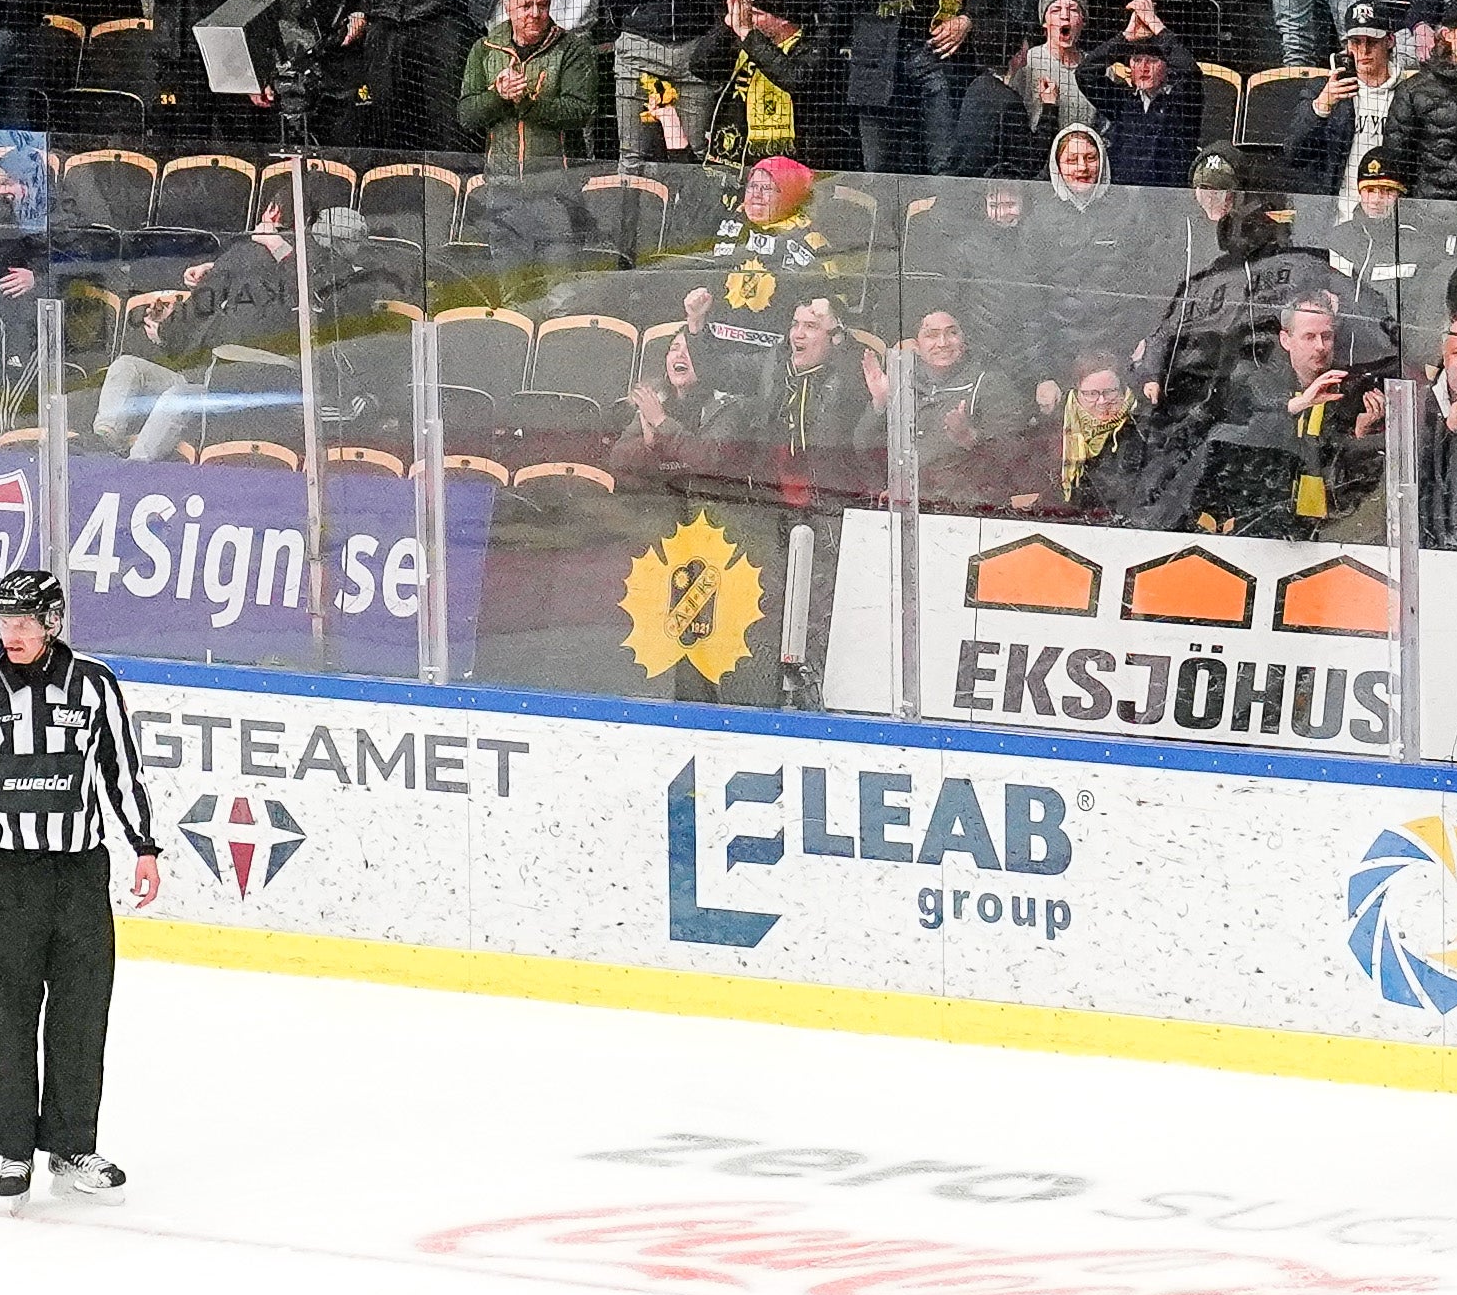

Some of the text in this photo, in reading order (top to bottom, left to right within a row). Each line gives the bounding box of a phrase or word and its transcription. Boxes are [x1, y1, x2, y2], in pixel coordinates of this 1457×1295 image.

[68, 491, 427, 628] 4Signse
[954, 640, 1402, 745] EKSJÖHUS
[2, 774, 74, 792] swedol
[132, 710, 530, 799] GTEAMET
[801, 765, 1073, 875] LEAB
[917, 882, 1072, 940] group
